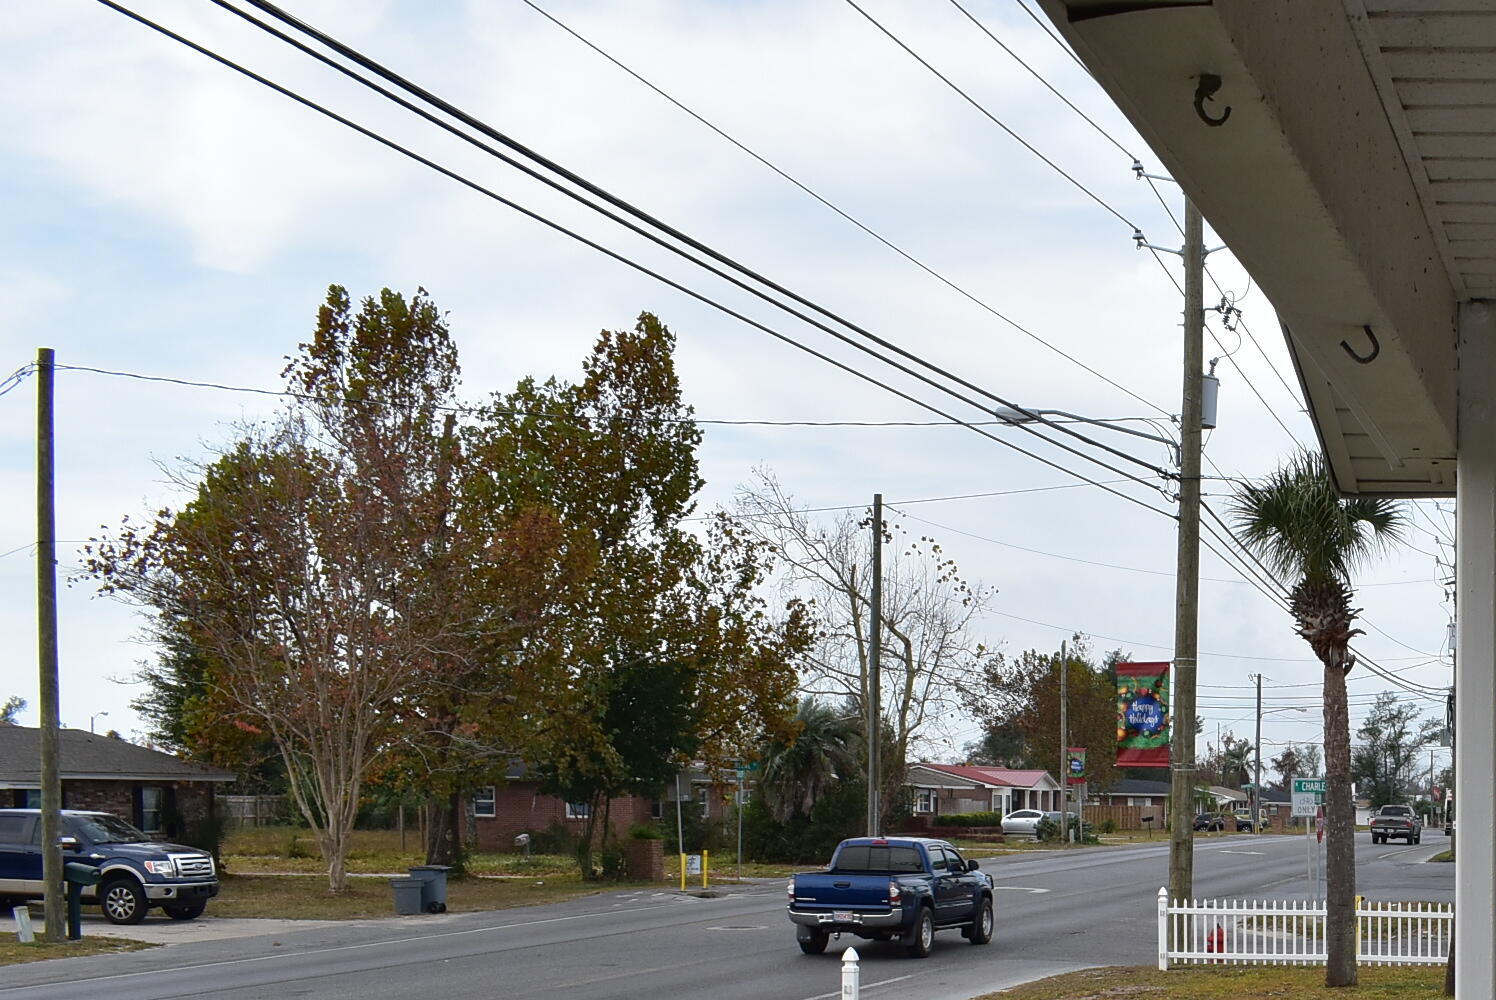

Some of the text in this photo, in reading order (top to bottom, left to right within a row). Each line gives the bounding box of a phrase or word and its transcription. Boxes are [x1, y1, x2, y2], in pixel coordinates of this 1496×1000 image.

[1132, 700, 1154, 716] Happy
[1129, 713, 1159, 728] Holidays
[1301, 781, 1326, 791] CHARLE
[1297, 805, 1315, 814] ONLY
